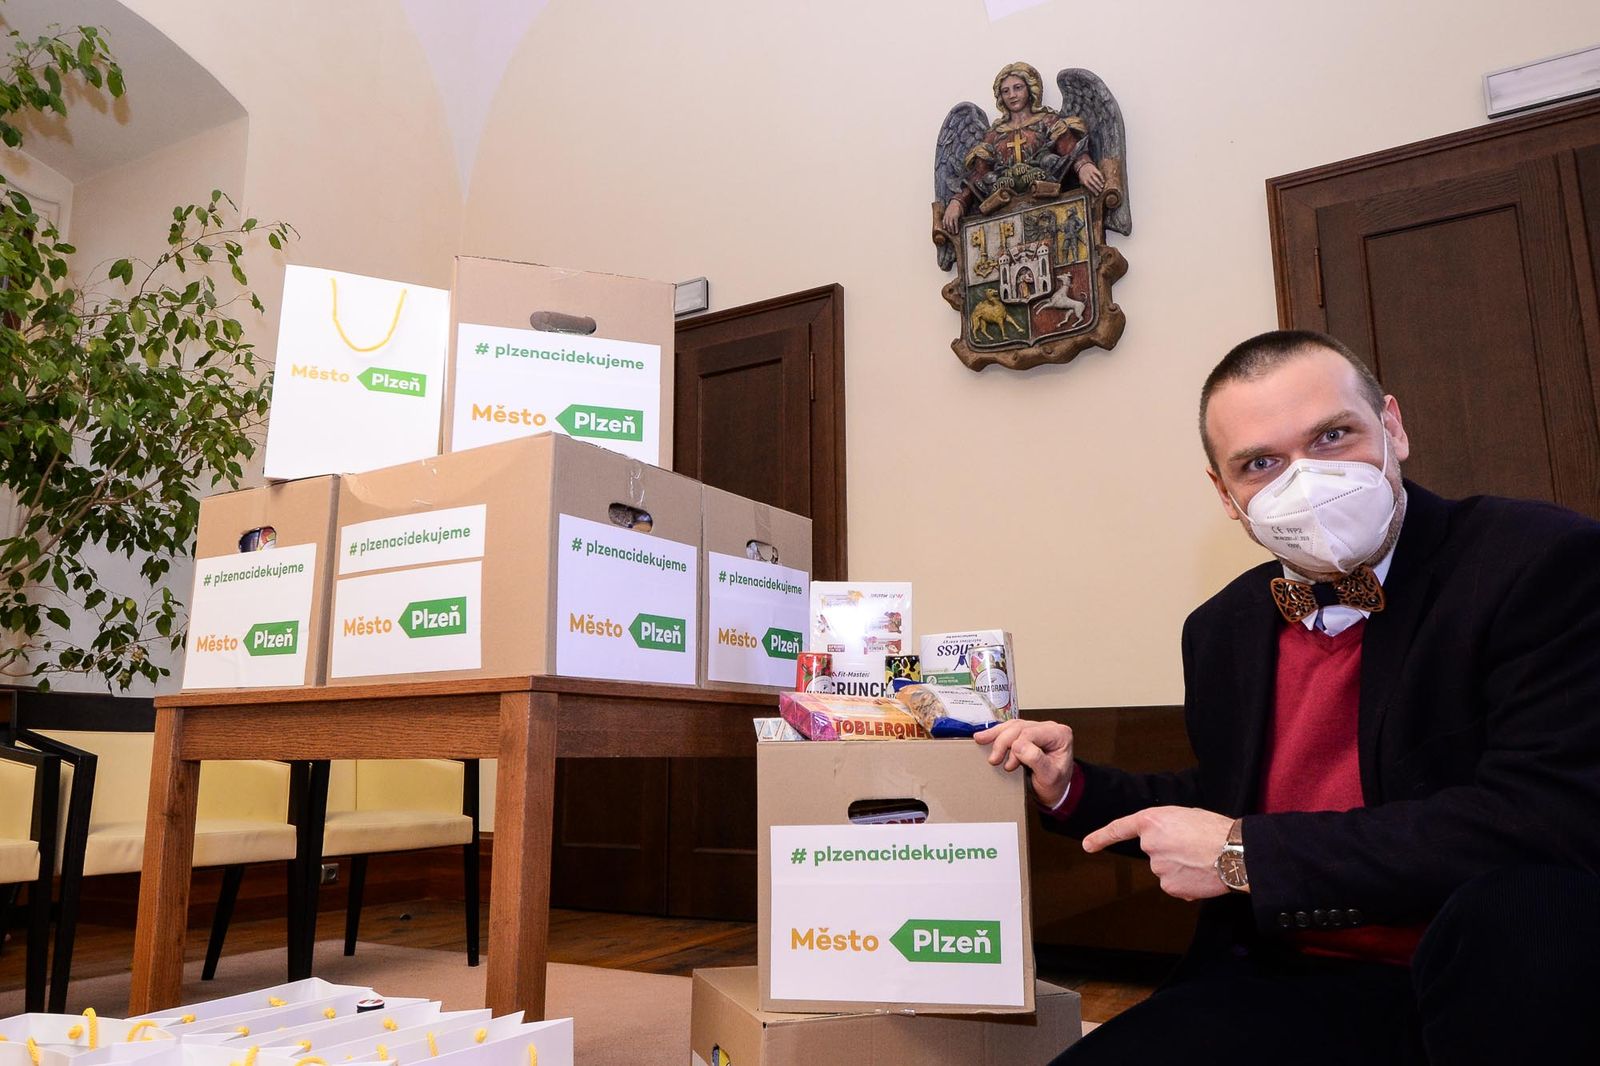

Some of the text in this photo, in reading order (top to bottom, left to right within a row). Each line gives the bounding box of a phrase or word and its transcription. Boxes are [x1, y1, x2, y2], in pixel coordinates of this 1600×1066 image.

[475, 342, 645, 371] # plzenacidekujeme
[291, 363, 421, 392] Město Plzeň
[471, 403, 636, 435] Město Plzeň
[349, 524, 471, 557] # plzenacidekujeme
[571, 537, 687, 574] # plzenacidekujeme
[203, 561, 304, 587] # plzenacidekujeme
[718, 570, 803, 595] # plzenacidekujeme
[343, 604, 462, 637] Město Plzeň
[569, 612, 682, 645] Město Plzeň
[196, 628, 294, 653] Město Plzeň
[718, 627, 799, 654] Město Plzeň
[834, 718, 925, 739] TOBLERONE
[790, 844, 998, 867] # plzenacidekujeme
[791, 928, 991, 954] Město Plzeň
